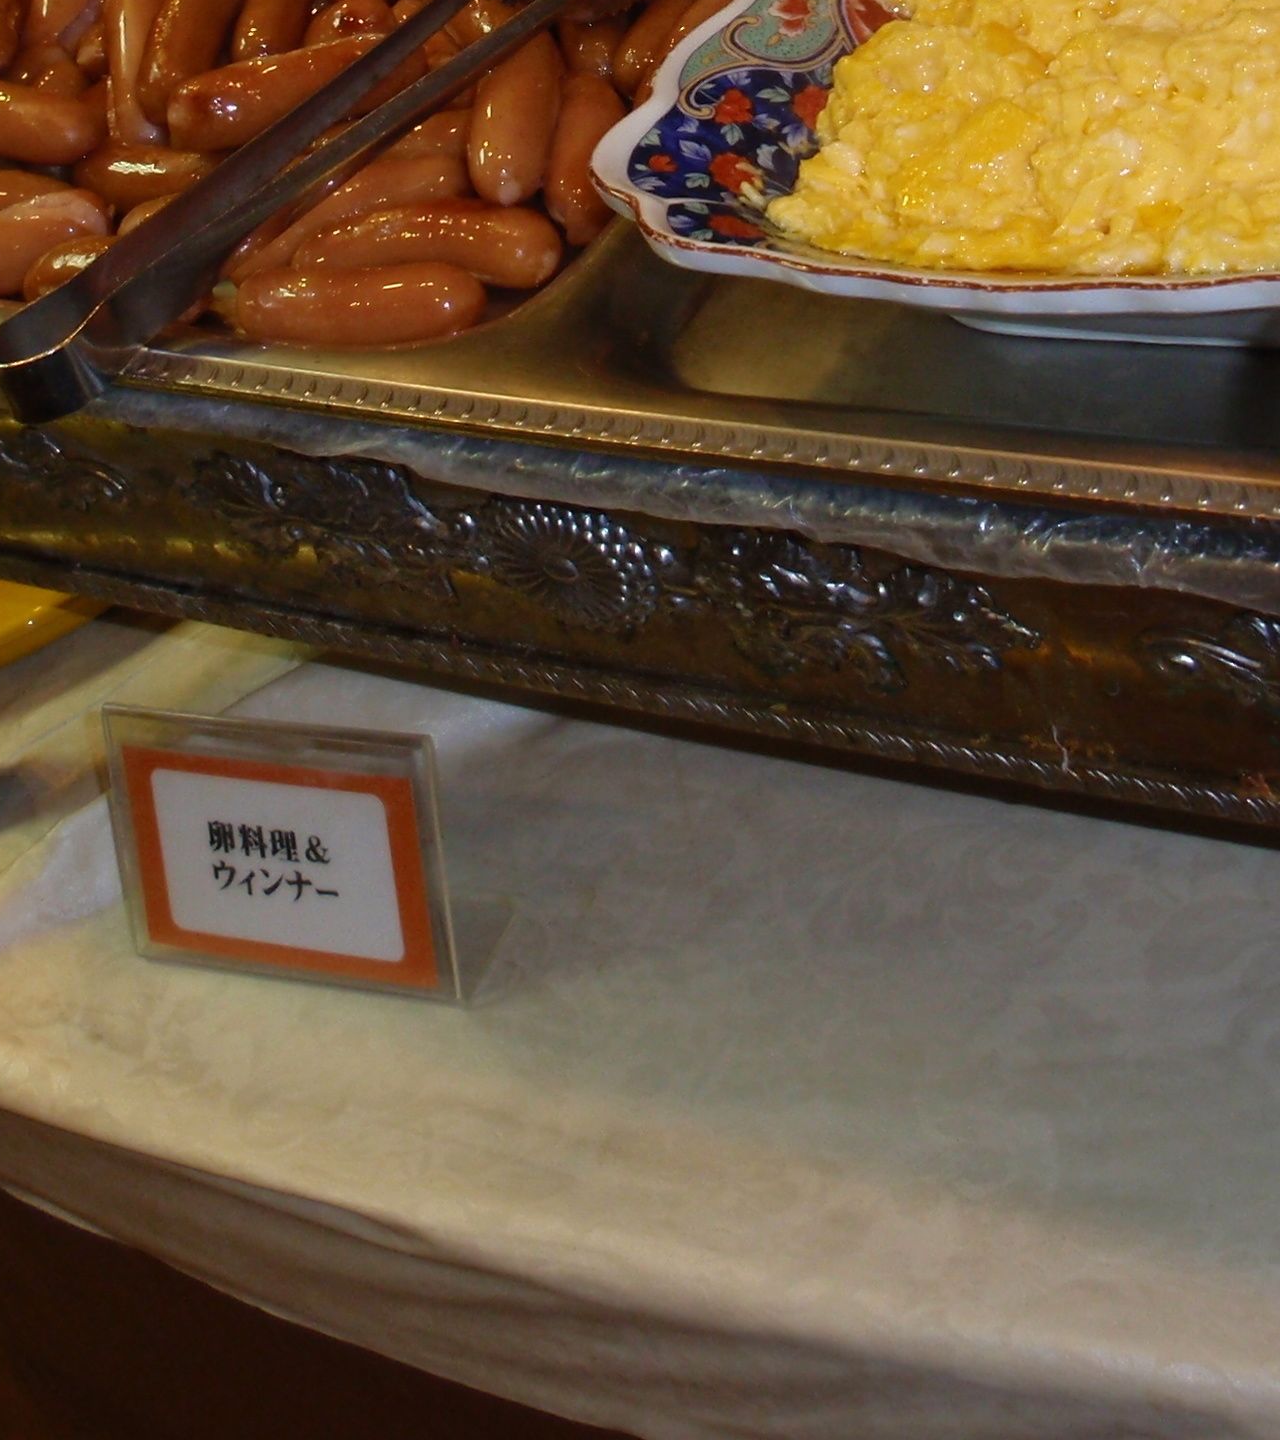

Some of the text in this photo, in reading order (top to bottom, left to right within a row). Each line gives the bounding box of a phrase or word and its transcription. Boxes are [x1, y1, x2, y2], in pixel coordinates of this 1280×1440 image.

[212, 860, 339, 901] ウィンナー
